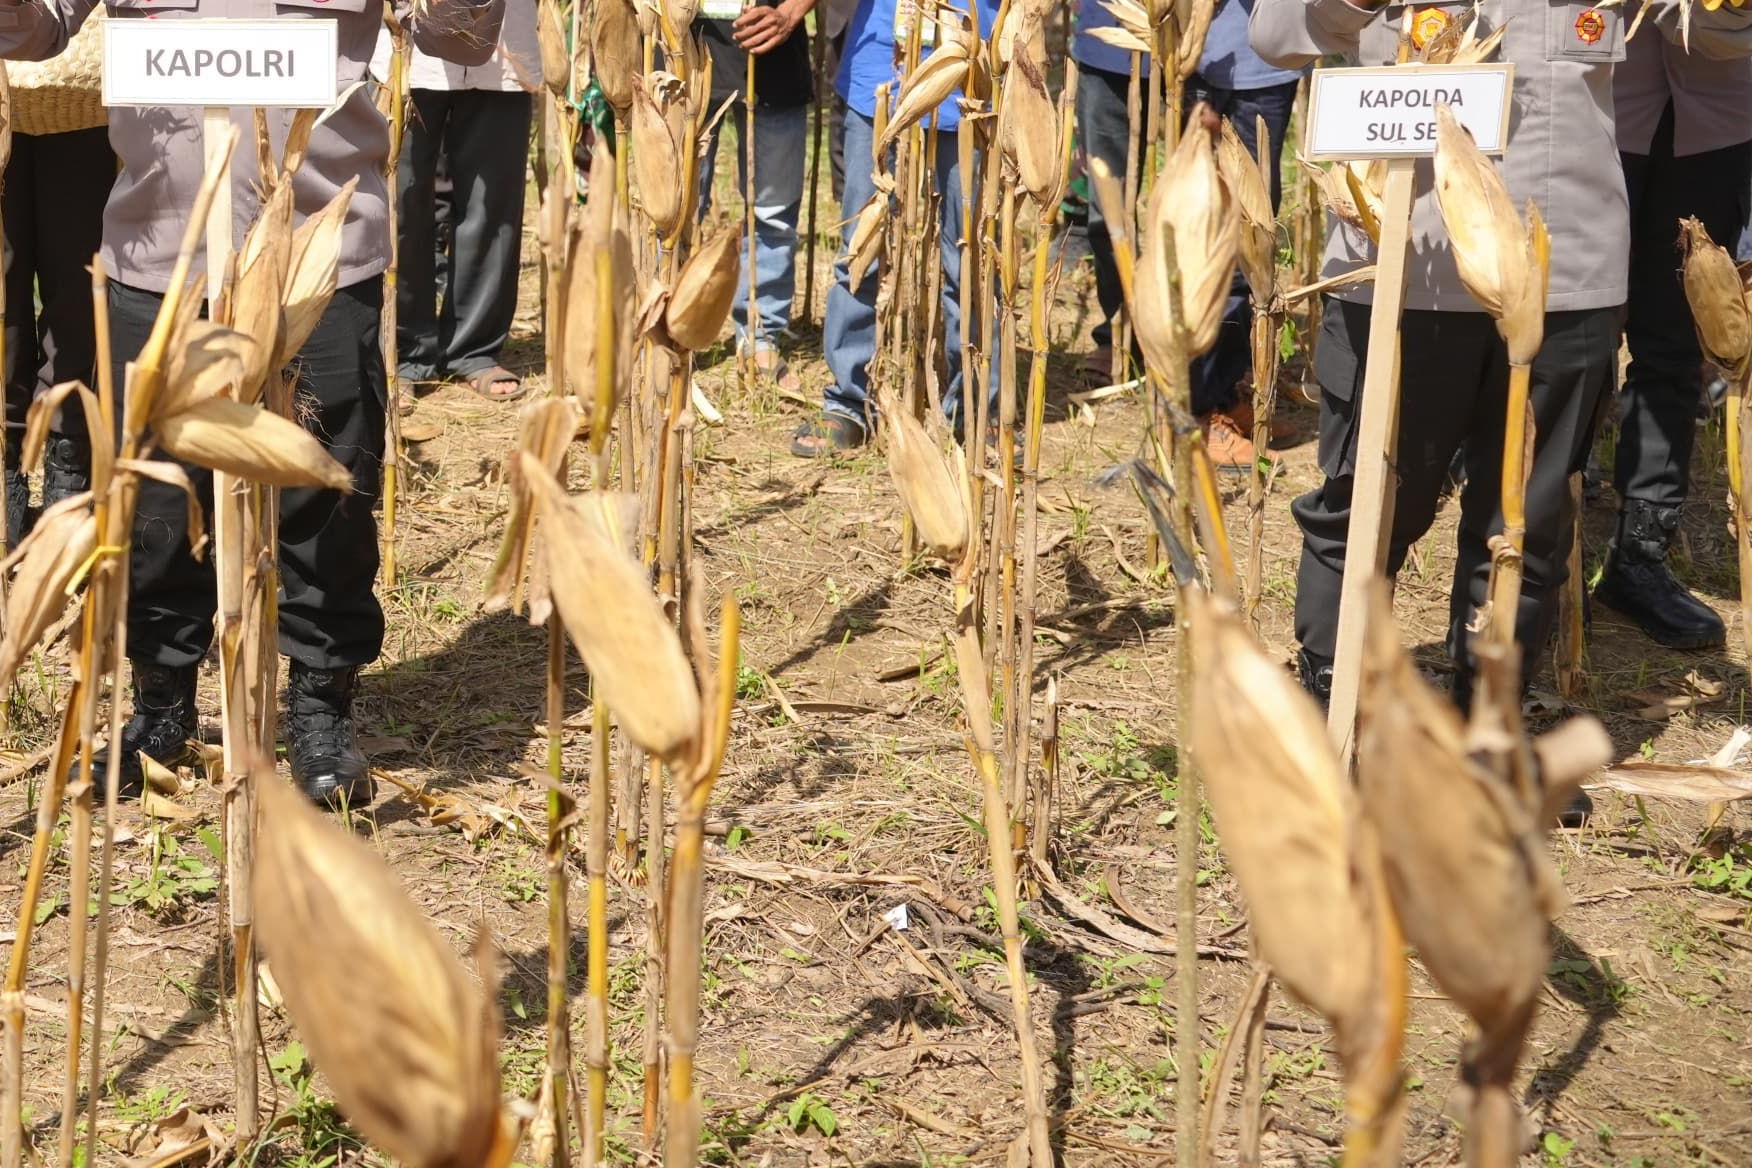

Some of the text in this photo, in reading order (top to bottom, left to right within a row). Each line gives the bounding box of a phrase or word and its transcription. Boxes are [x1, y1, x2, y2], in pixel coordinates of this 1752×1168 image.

[146, 49, 295, 78] KAPOLRI
[1359, 88, 1464, 108] KAPOLDA
[1366, 122, 1407, 141] SUL
